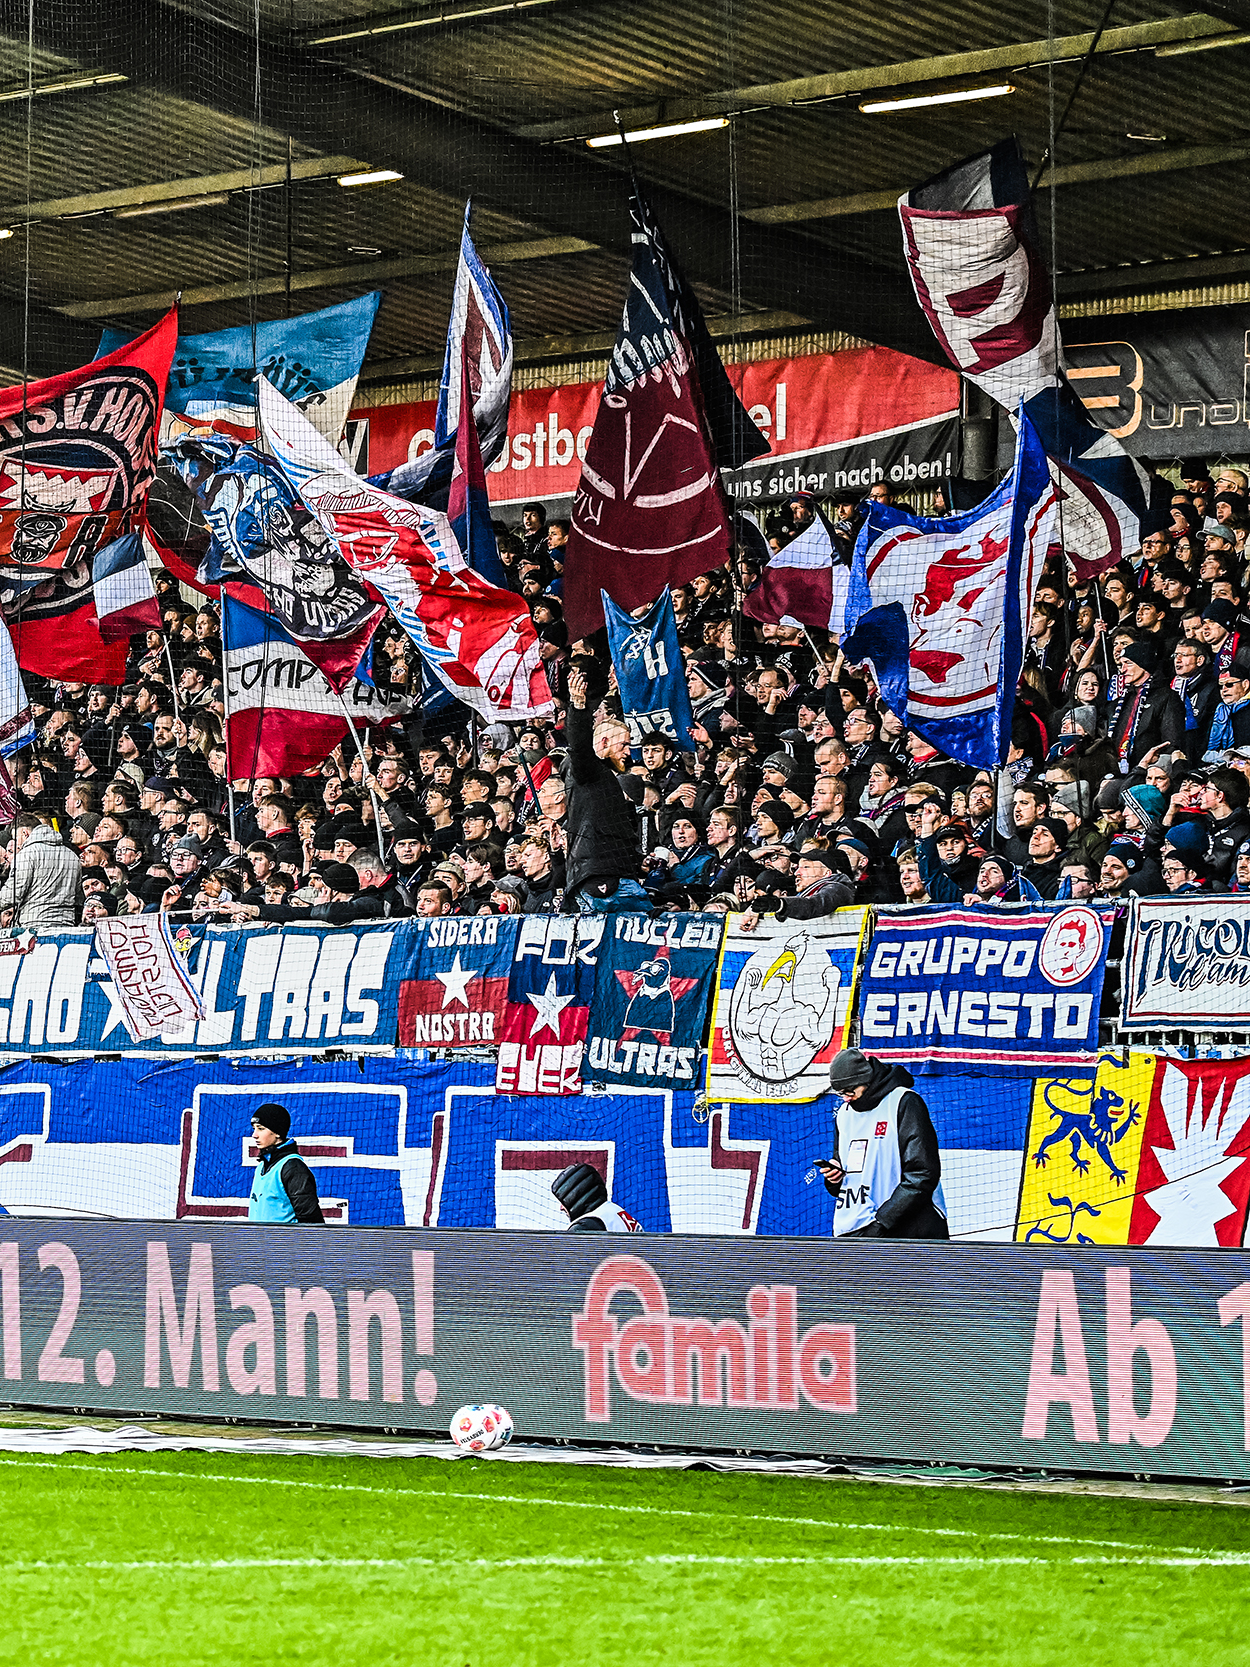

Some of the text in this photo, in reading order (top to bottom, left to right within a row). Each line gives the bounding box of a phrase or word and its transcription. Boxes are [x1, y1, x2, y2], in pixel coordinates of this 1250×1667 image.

[769, 466, 827, 496] sicher
[834, 458, 883, 488] nach
[890, 452, 952, 482] oben!
[427, 918, 498, 947] SIDERA
[515, 914, 607, 965] FOR
[615, 914, 722, 949] NUCLEO
[869, 935, 1039, 979] GRUPPO
[415, 1012, 495, 1043] NOSTRA
[862, 990, 1094, 1040] ERNESTO
[588, 1036, 699, 1079] ULTRAS
[144, 1241, 438, 1407] Mann!
[571, 1254, 859, 1423] famila
[1021, 1266, 1178, 1449] Ab
